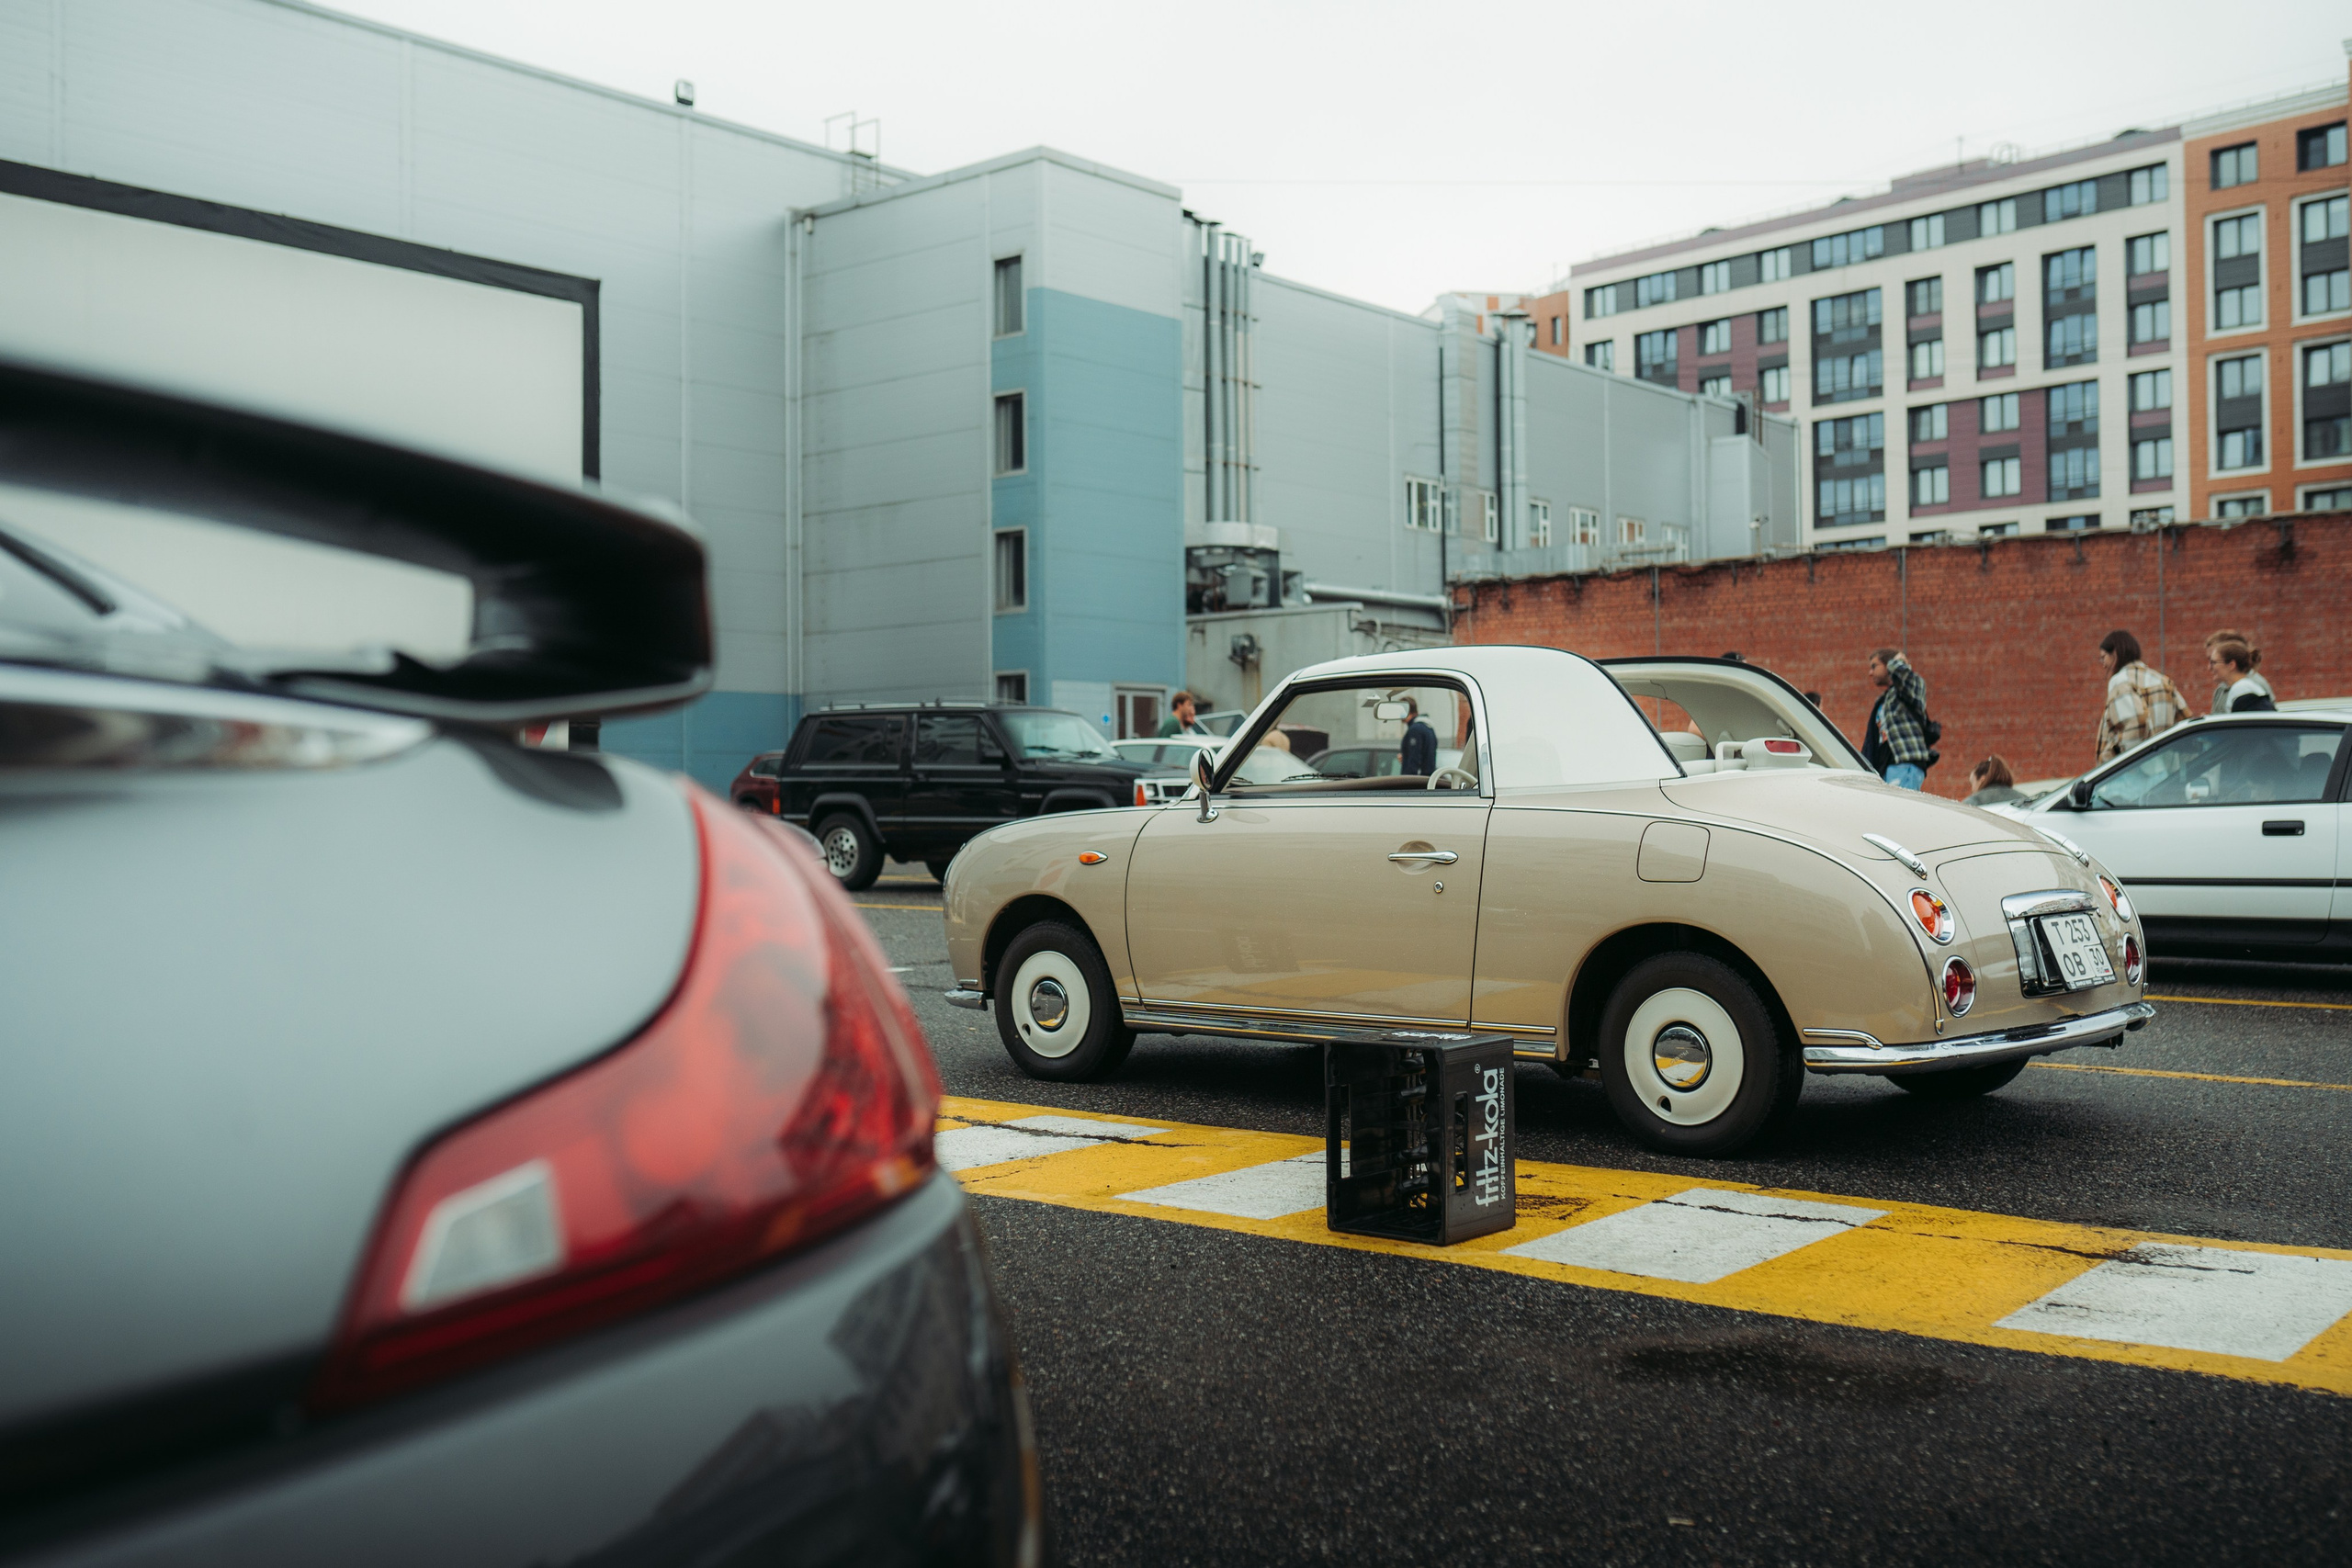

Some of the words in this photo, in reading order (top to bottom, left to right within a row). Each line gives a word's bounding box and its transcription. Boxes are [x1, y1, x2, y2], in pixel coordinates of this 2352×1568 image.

[2051, 921, 2064, 945] T
[2064, 919, 2091, 943] 253
[2088, 947, 2105, 966] 30
